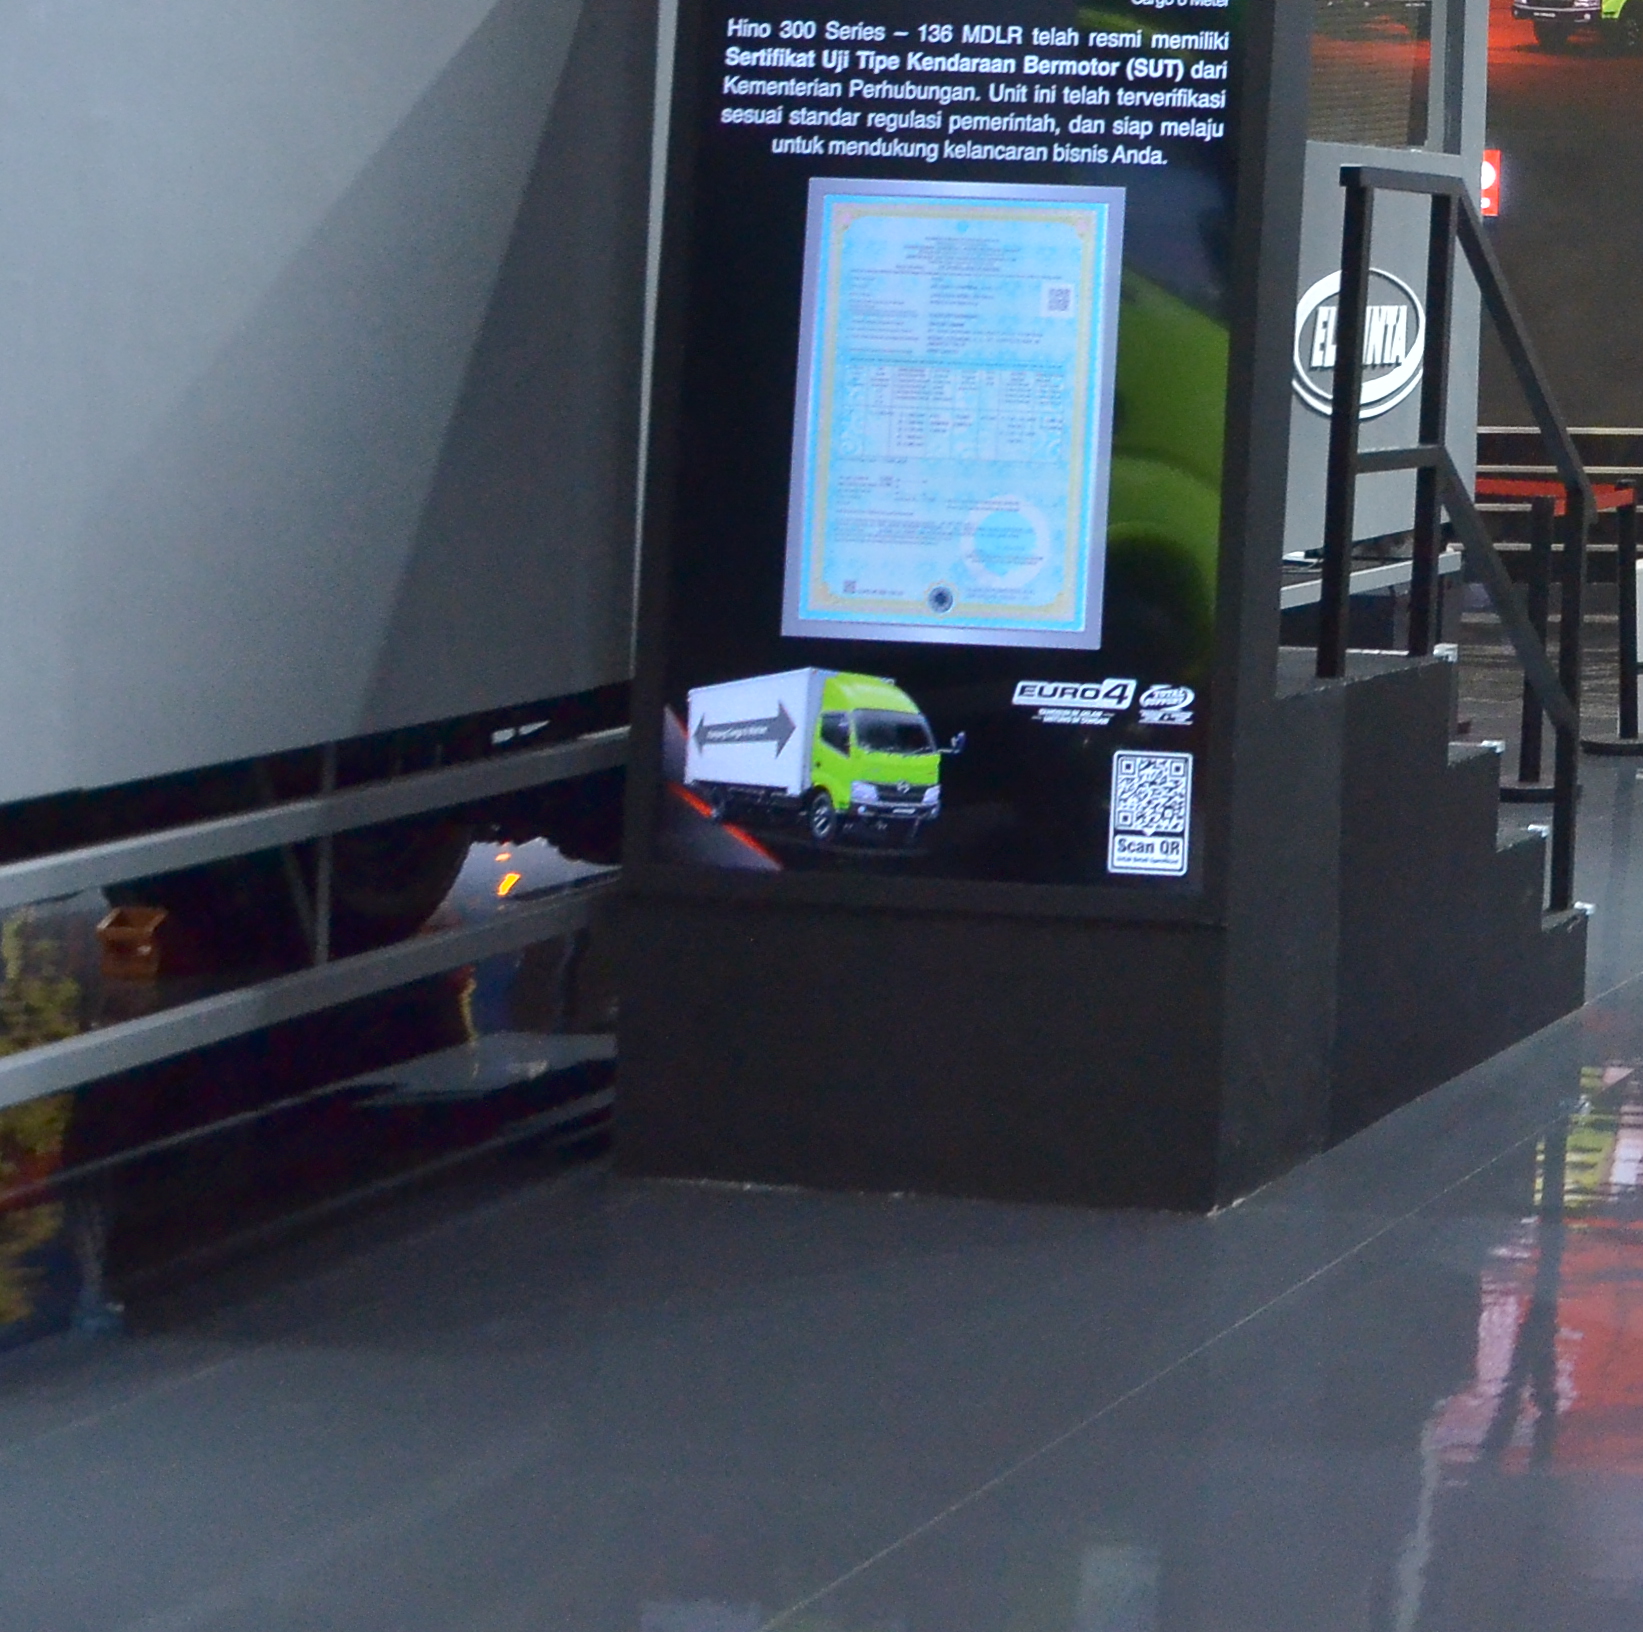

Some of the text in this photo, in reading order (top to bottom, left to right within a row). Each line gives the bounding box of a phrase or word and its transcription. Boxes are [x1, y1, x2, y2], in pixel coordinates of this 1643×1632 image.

[727, 18, 772, 39] Hino
[778, 19, 818, 40] 300
[825, 20, 886, 42] Series
[917, 22, 953, 44] 136
[962, 24, 1023, 46] MDLR
[1032, 25, 1080, 48] telah
[1088, 28, 1142, 49] resmi
[1151, 29, 1229, 52] memiliki
[724, 46, 1228, 82] Sertifikat Uji Tipe Kendaraan Bermotor (SUT) dari
[722, 76, 1227, 111] Kementerian Perhubungan. Unit ini telah terverifikasi
[720, 105, 1225, 144] sesuai standar regulasi pemerintah, dan siap melaju
[771, 134, 1169, 167] untuk mendukung kelancaran bisnis Anda.
[1018, 683, 1130, 705] EURO4
[1117, 837, 1181, 856] Scan QR
